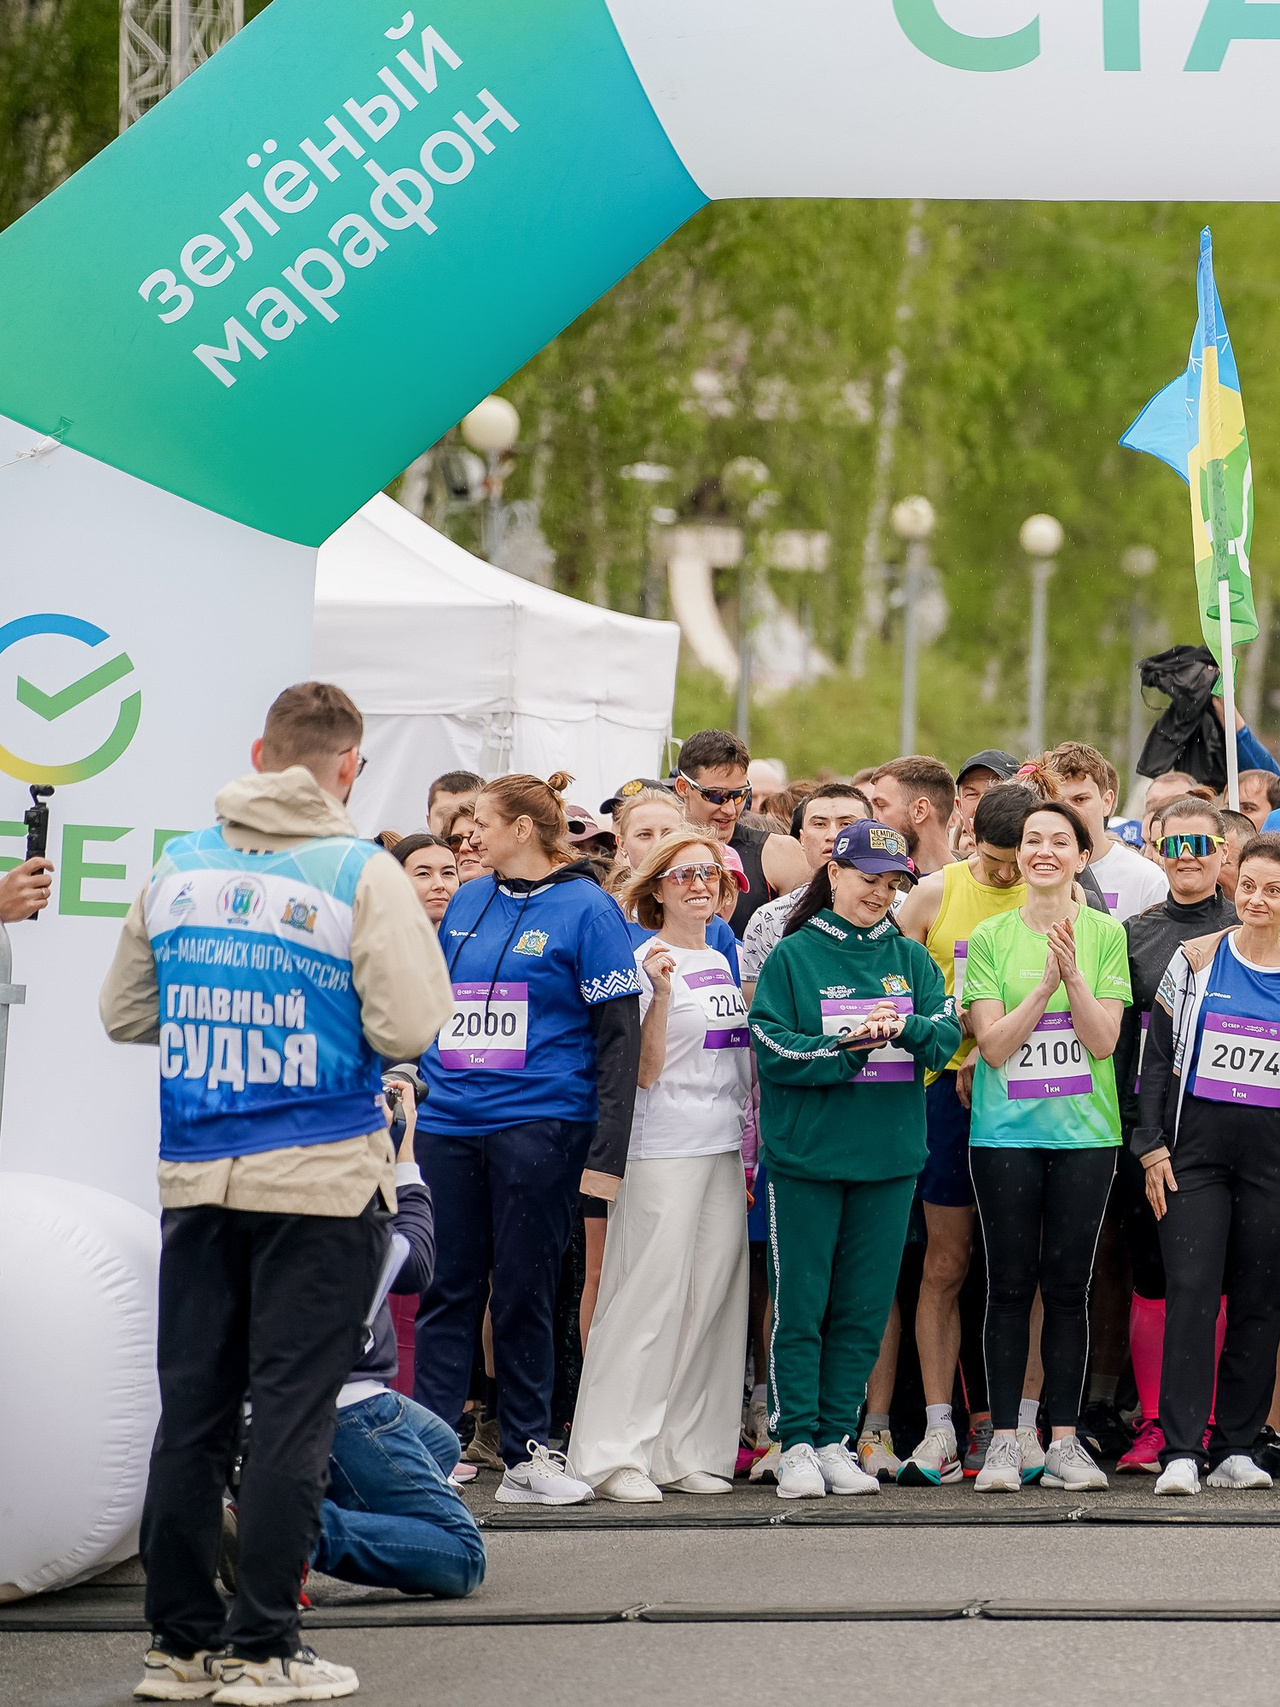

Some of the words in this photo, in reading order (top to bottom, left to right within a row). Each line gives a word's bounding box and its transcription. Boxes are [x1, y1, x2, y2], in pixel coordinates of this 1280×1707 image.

[138, 10, 464, 324] зелёный
[191, 87, 521, 389] марафон
[250, 943, 293, 974] ЮГРА
[166, 983, 306, 1030] ГЛАВНЫЙ
[451, 1012, 517, 1037] 2000
[159, 1022, 318, 1092] СУДЬЯ
[1019, 1039, 1081, 1068] 2100
[1211, 1044, 1280, 1076] 2074
